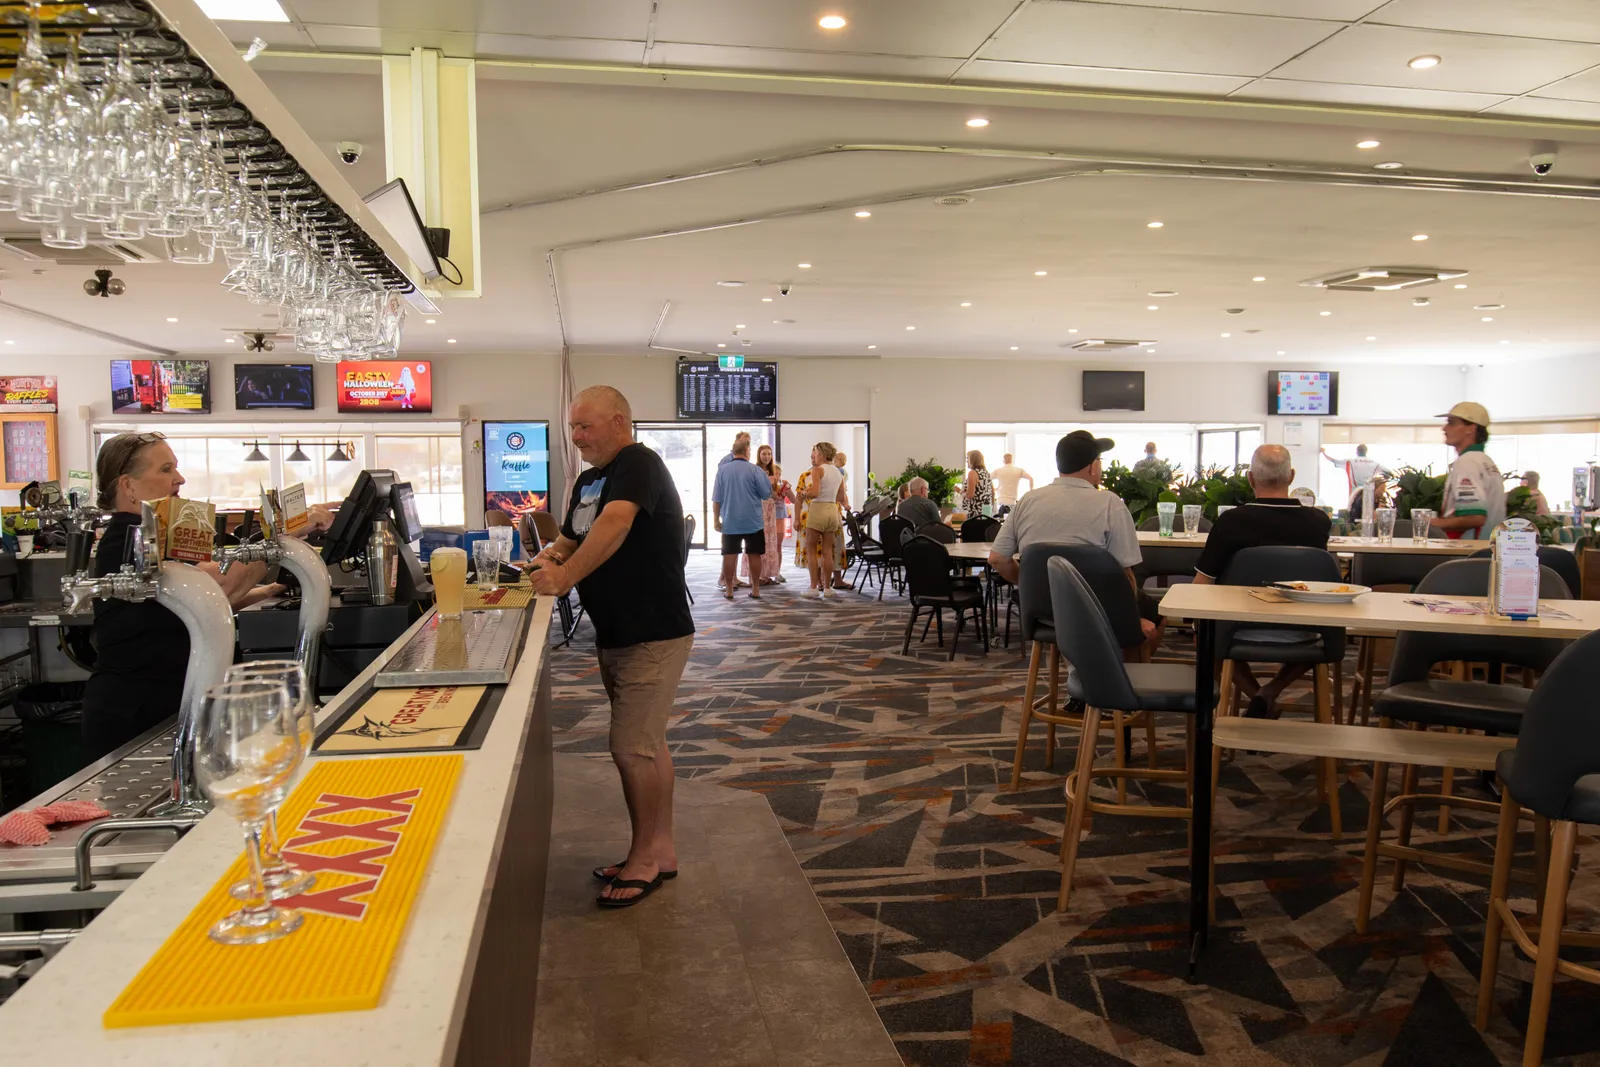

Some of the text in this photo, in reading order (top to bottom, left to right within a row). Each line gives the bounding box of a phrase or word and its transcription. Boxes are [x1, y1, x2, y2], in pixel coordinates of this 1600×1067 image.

[346, 371, 391, 382] EASTY
[5, 389, 48, 401] RAFFLES
[501, 459, 531, 472] Raffle
[286, 493, 303, 504] BALTER
[174, 526, 212, 541] GREAT
[173, 536, 212, 548] NORTHERN
[390, 700, 431, 724] GREAT
[268, 788, 422, 921] XXXX
